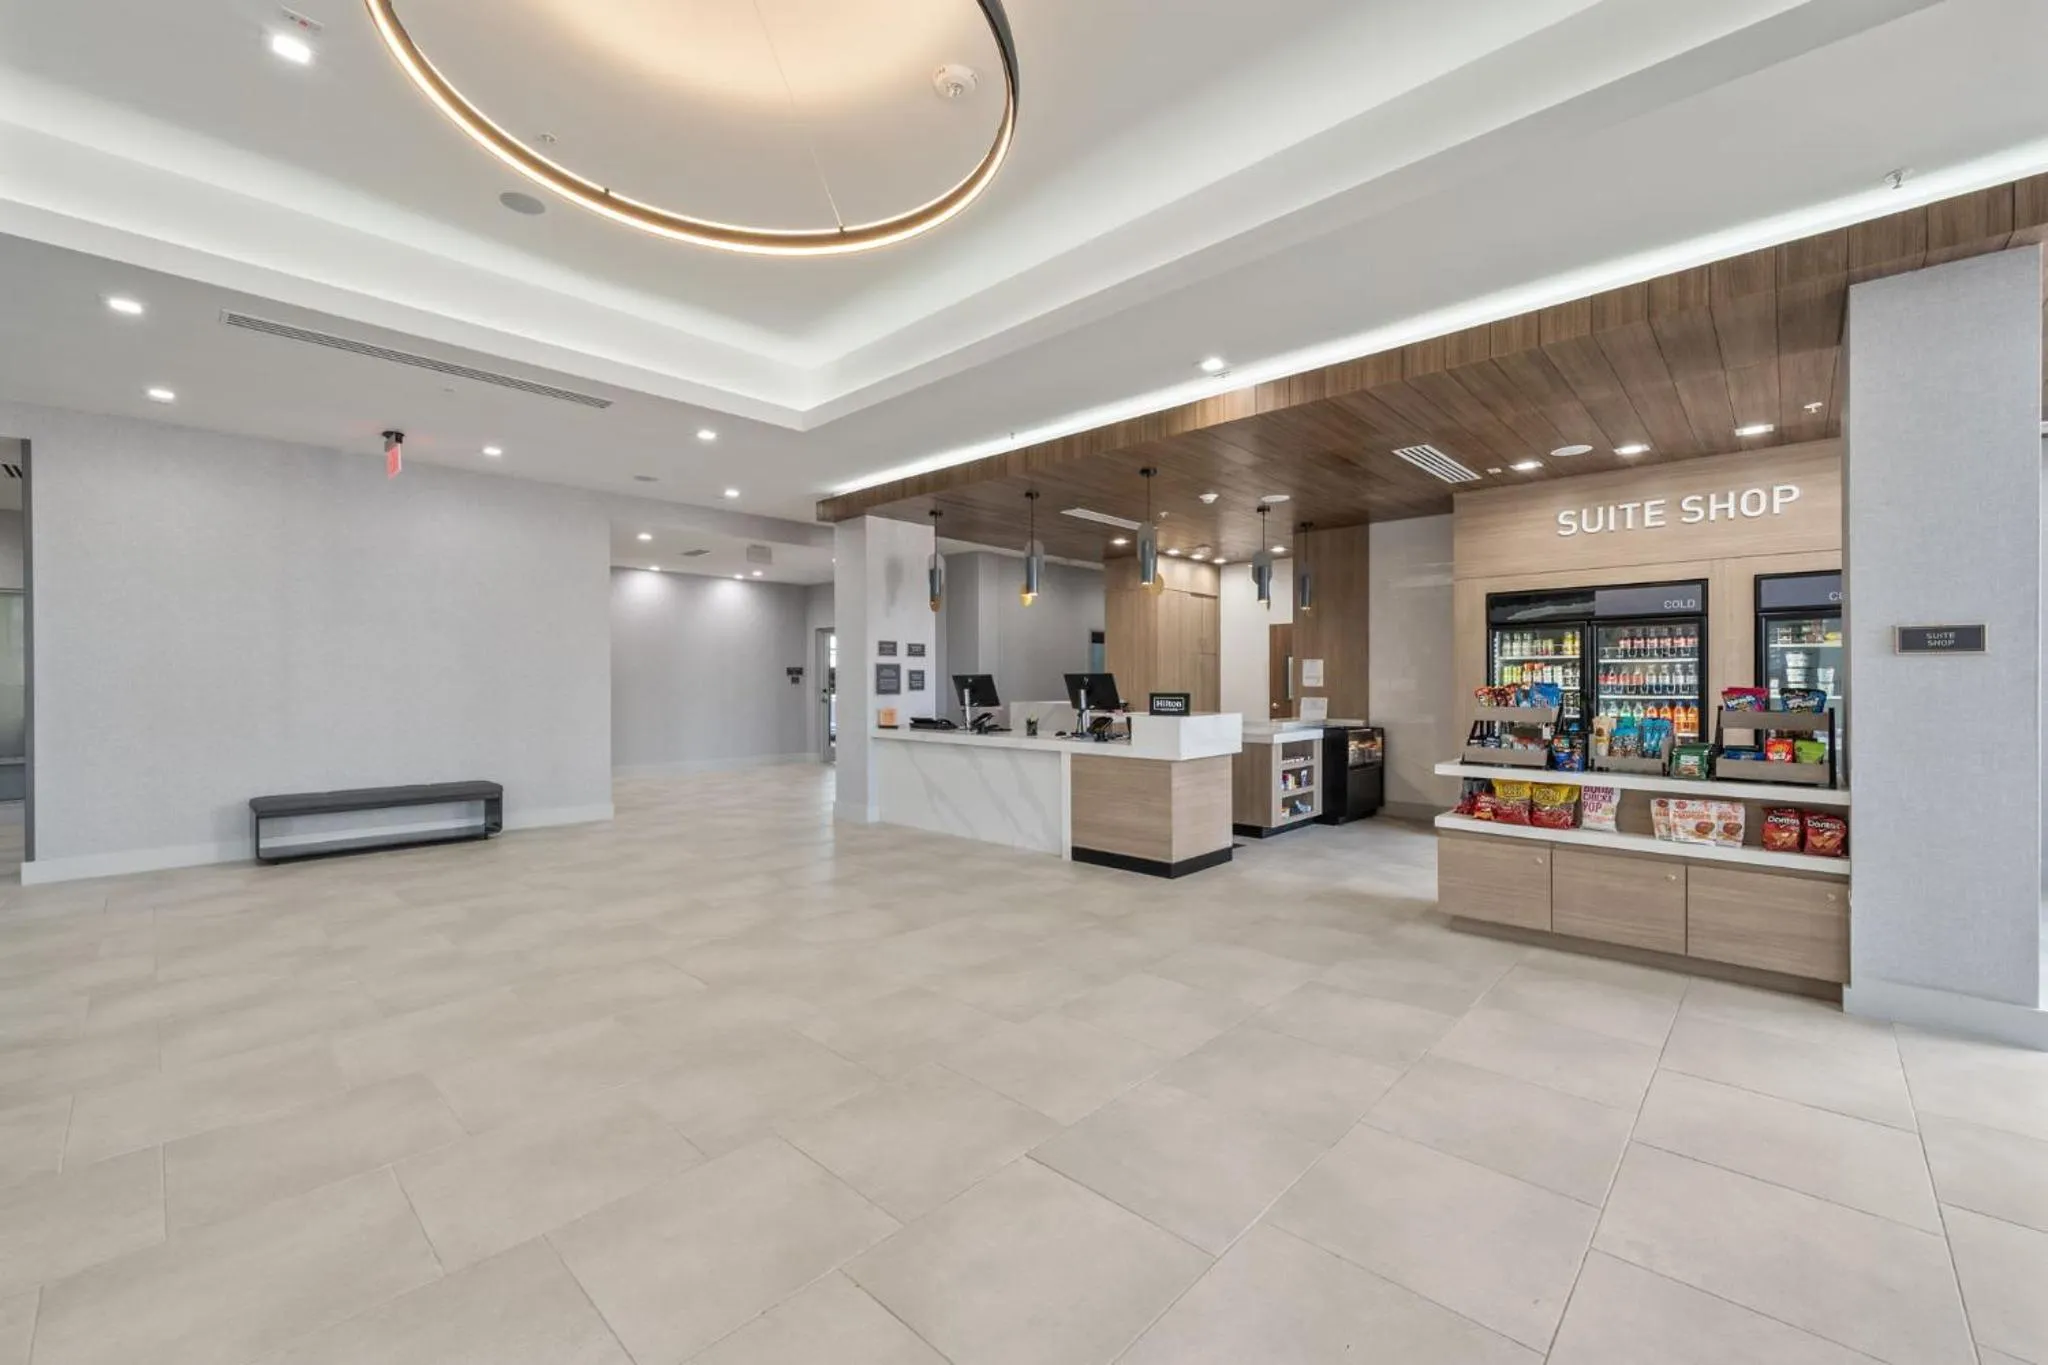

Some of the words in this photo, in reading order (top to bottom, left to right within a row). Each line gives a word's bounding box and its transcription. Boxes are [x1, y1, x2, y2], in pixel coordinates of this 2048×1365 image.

[1557, 499, 1666, 537] SUITE
[1680, 484, 1800, 524] SHOP
[1664, 599, 1695, 609] COLD
[1156, 700, 1182, 708] Hilton
